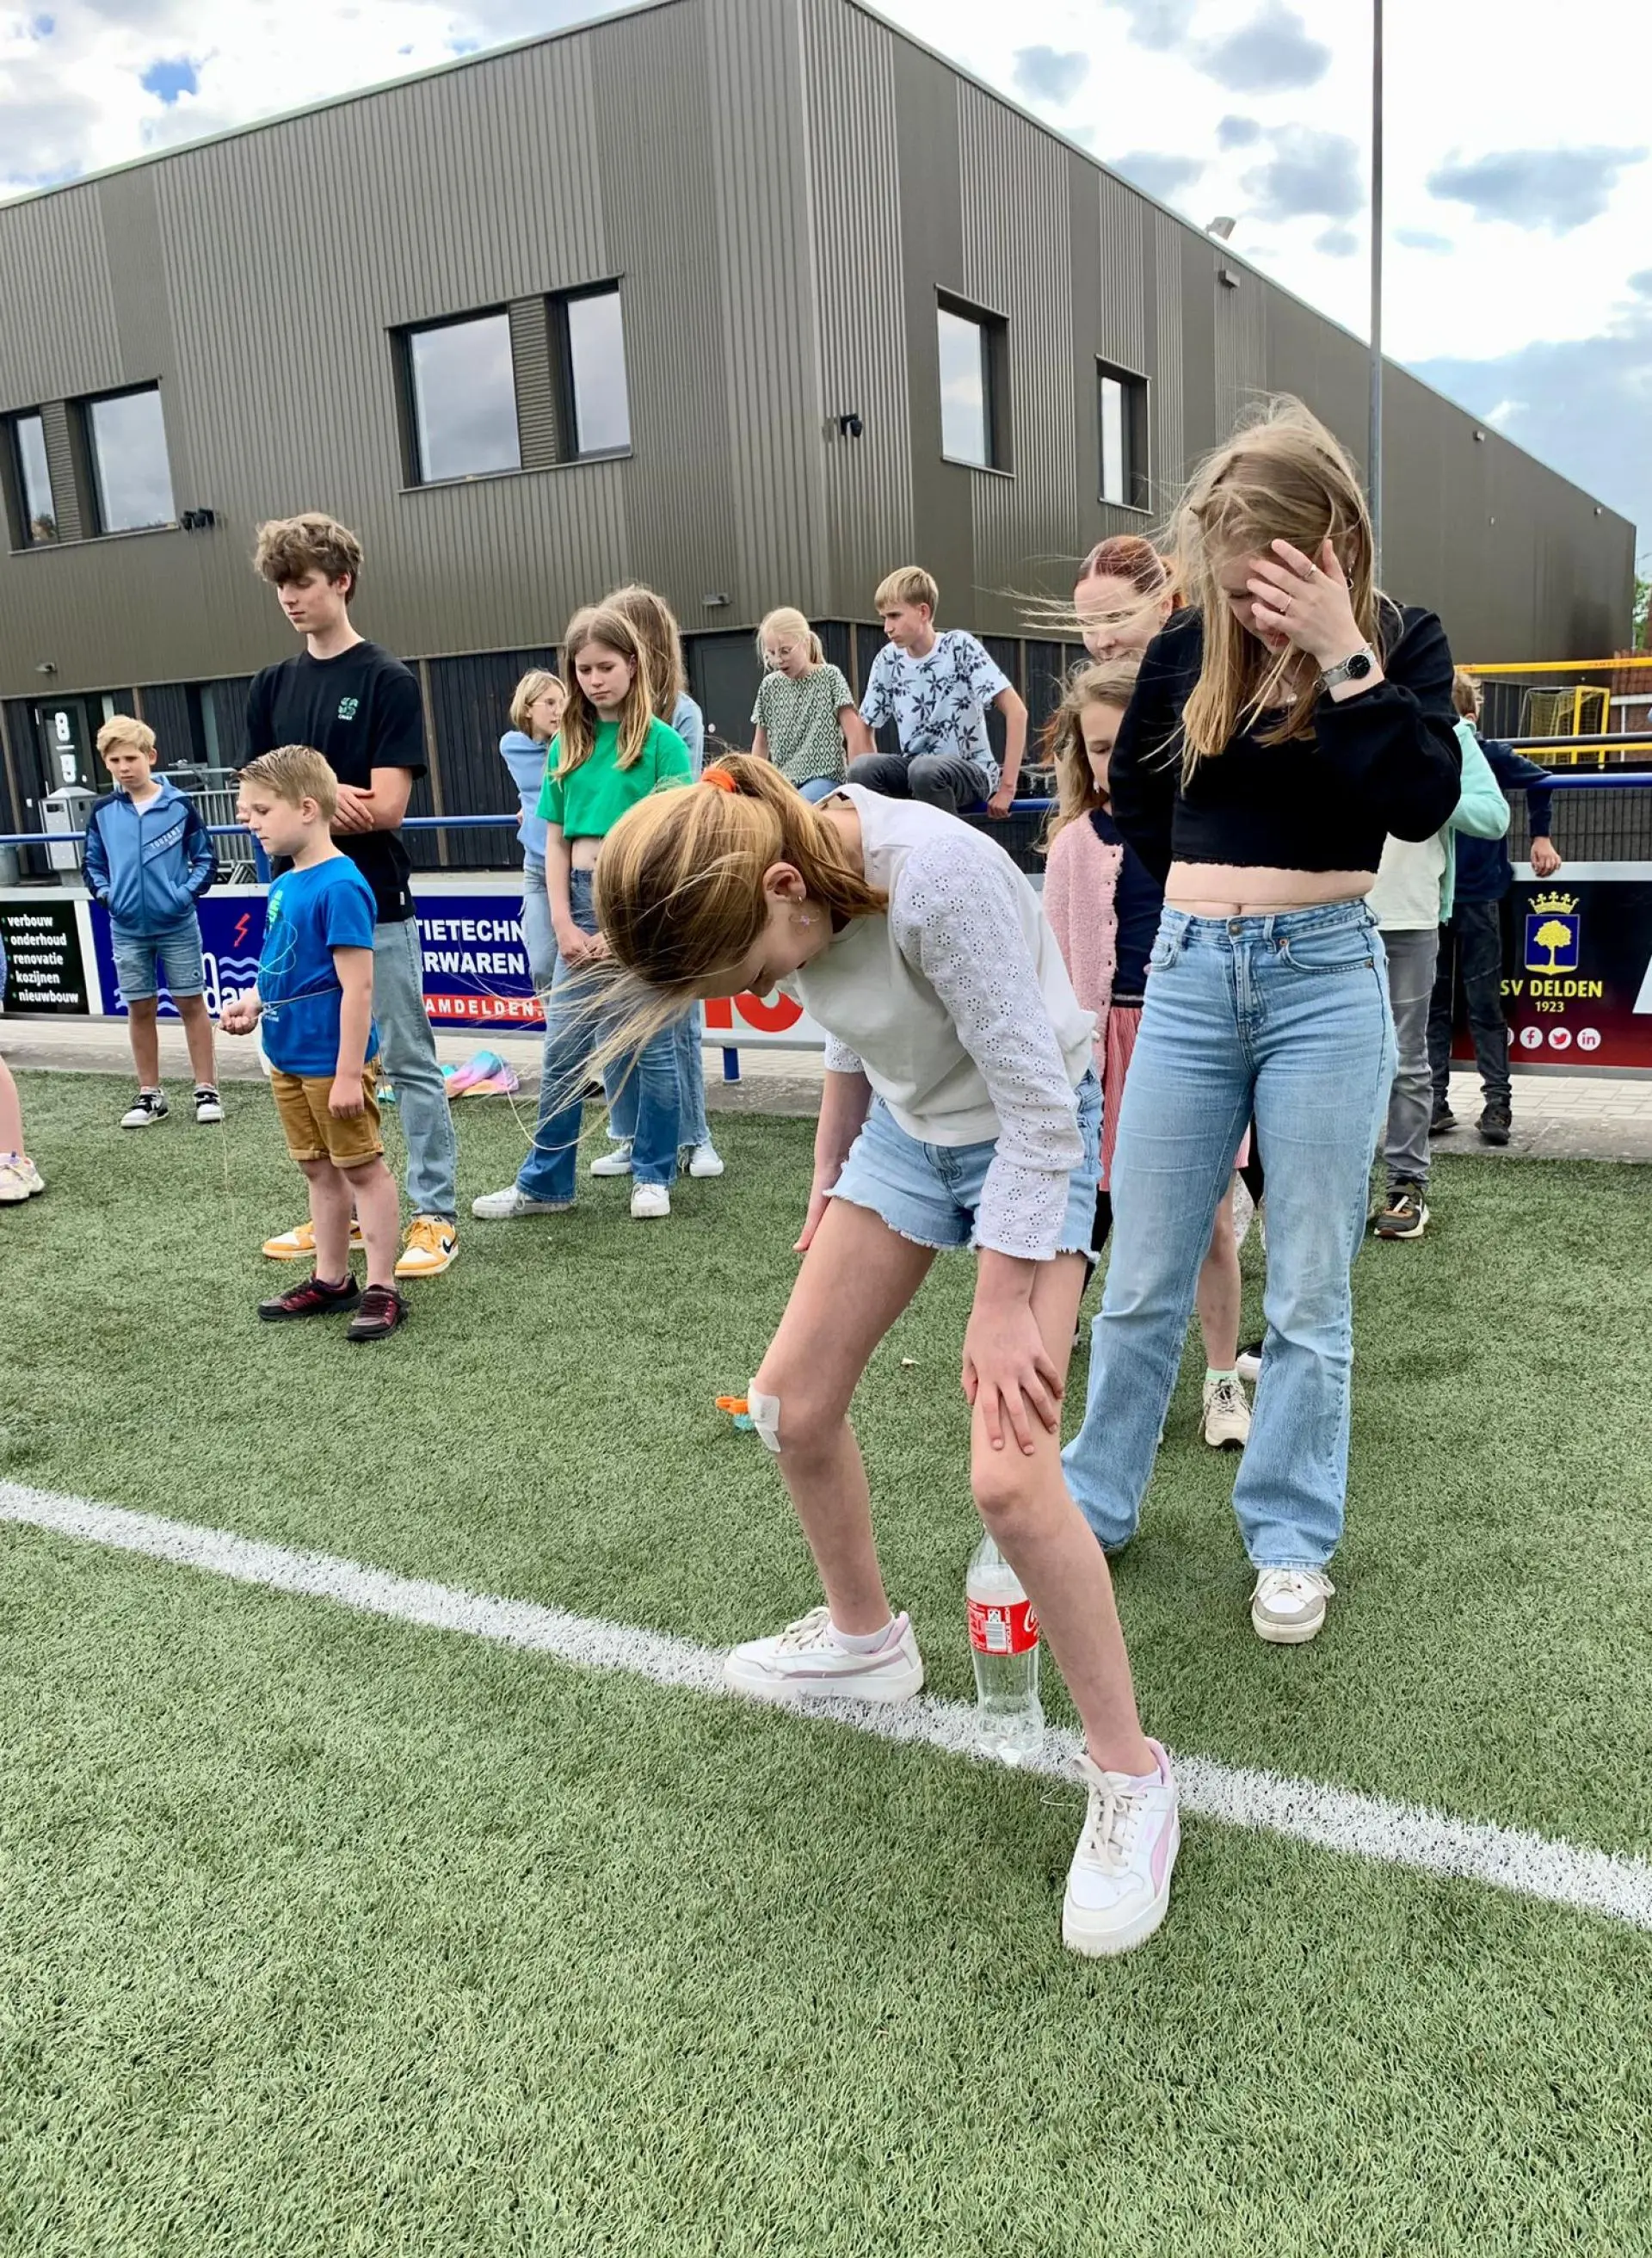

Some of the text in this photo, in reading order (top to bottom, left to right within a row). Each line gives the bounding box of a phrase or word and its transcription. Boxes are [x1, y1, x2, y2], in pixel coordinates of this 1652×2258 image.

[54, 712, 71, 742] 8
[7, 914, 53, 927] verbouw
[10, 932, 67, 946] onderhoud
[13, 952, 64, 966] renovatie
[422, 951, 526, 975] RWAREN
[15, 970, 60, 987] kozijnen
[1500, 979, 1603, 998] SV DELDEN
[18, 989, 79, 1003] nieuwbouw
[1535, 1001, 1565, 1013] 1923
